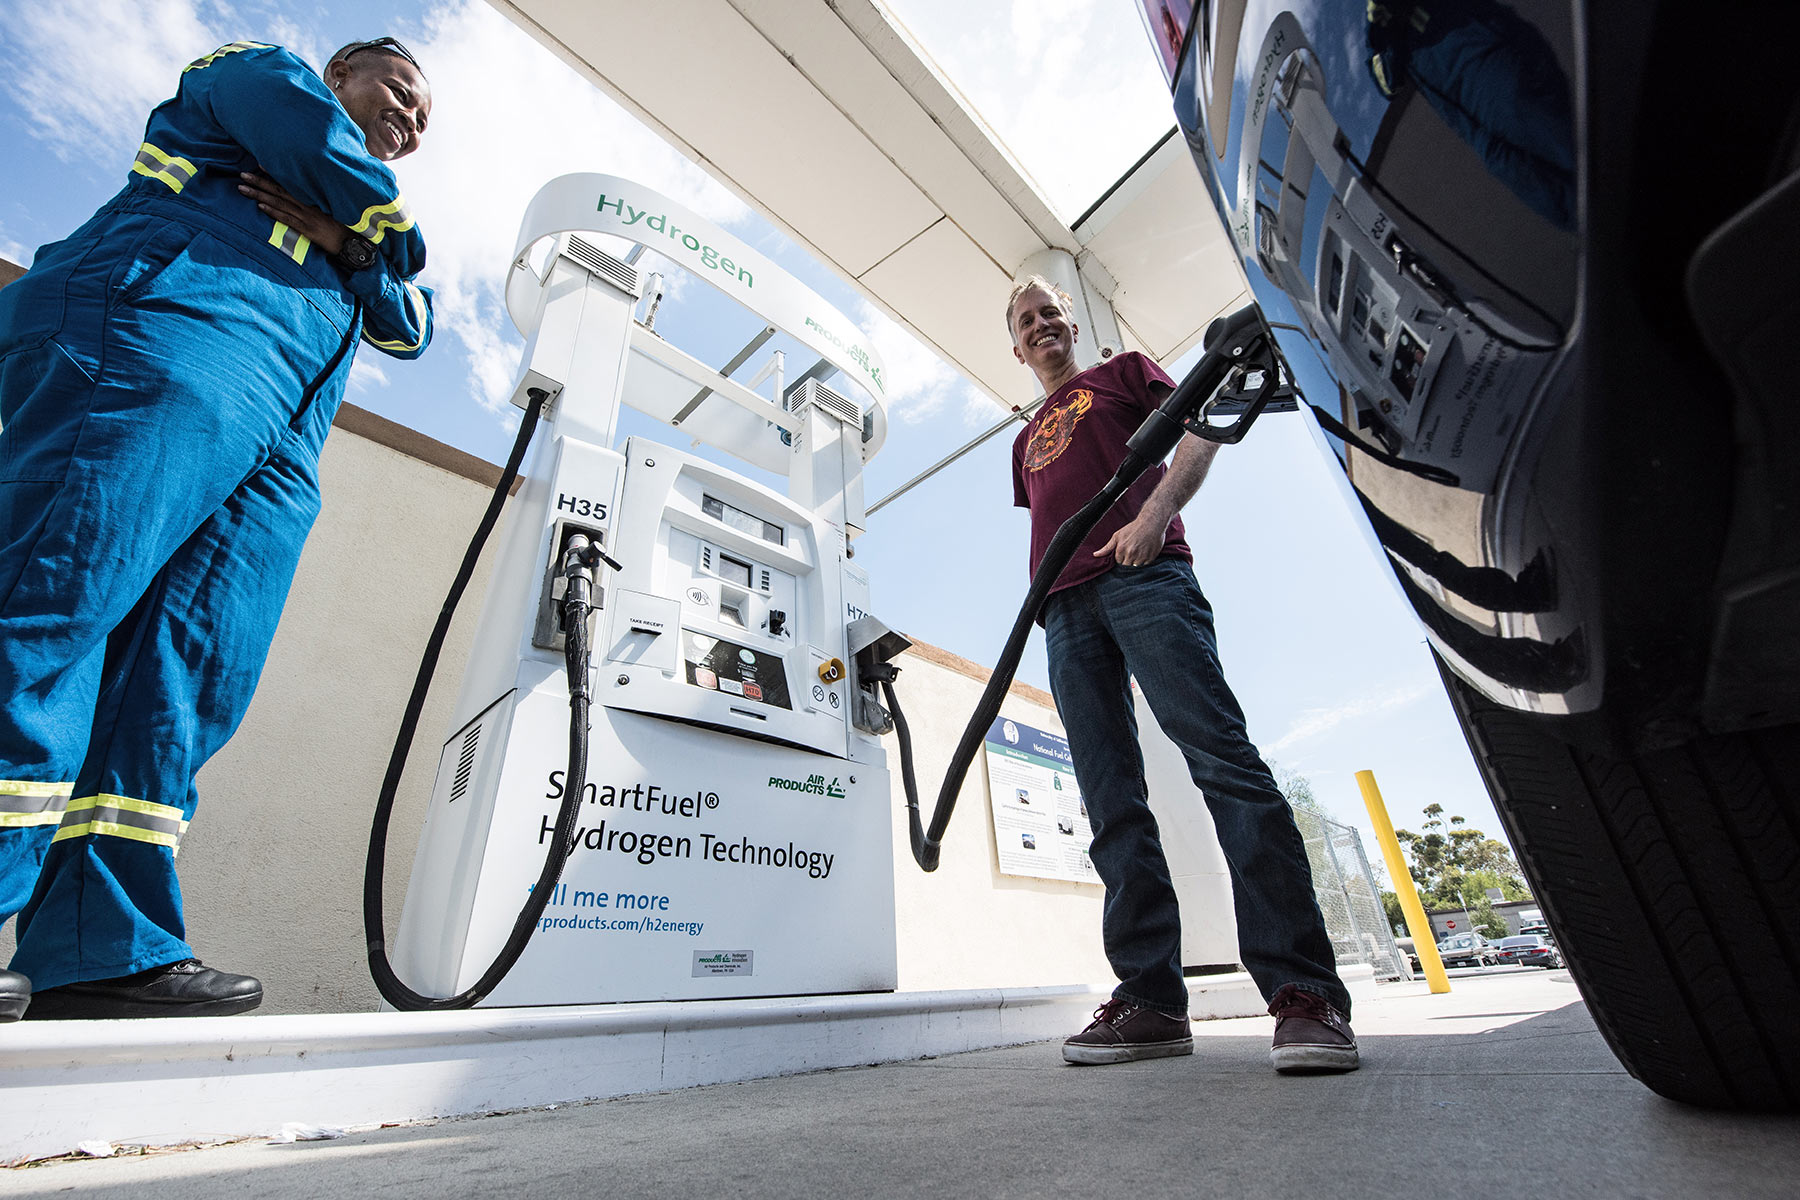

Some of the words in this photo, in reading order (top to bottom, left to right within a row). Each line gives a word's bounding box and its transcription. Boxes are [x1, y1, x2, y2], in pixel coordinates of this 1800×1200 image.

[597, 194, 753, 288] Hydrogen
[805, 316, 870, 373] PRODUCTS
[557, 493, 607, 520] H35
[642, 620, 664, 628] RECEIPT
[768, 776, 825, 795] PRODUCTS
[807, 774, 825, 786] AIR
[538, 815, 691, 865] Hydrogen
[700, 833, 834, 878] Technology
[528, 883, 567, 906] ll
[573, 890, 609, 908] me
[615, 892, 670, 911] more
[537, 914, 704, 936] rproducts.com/h2energy
